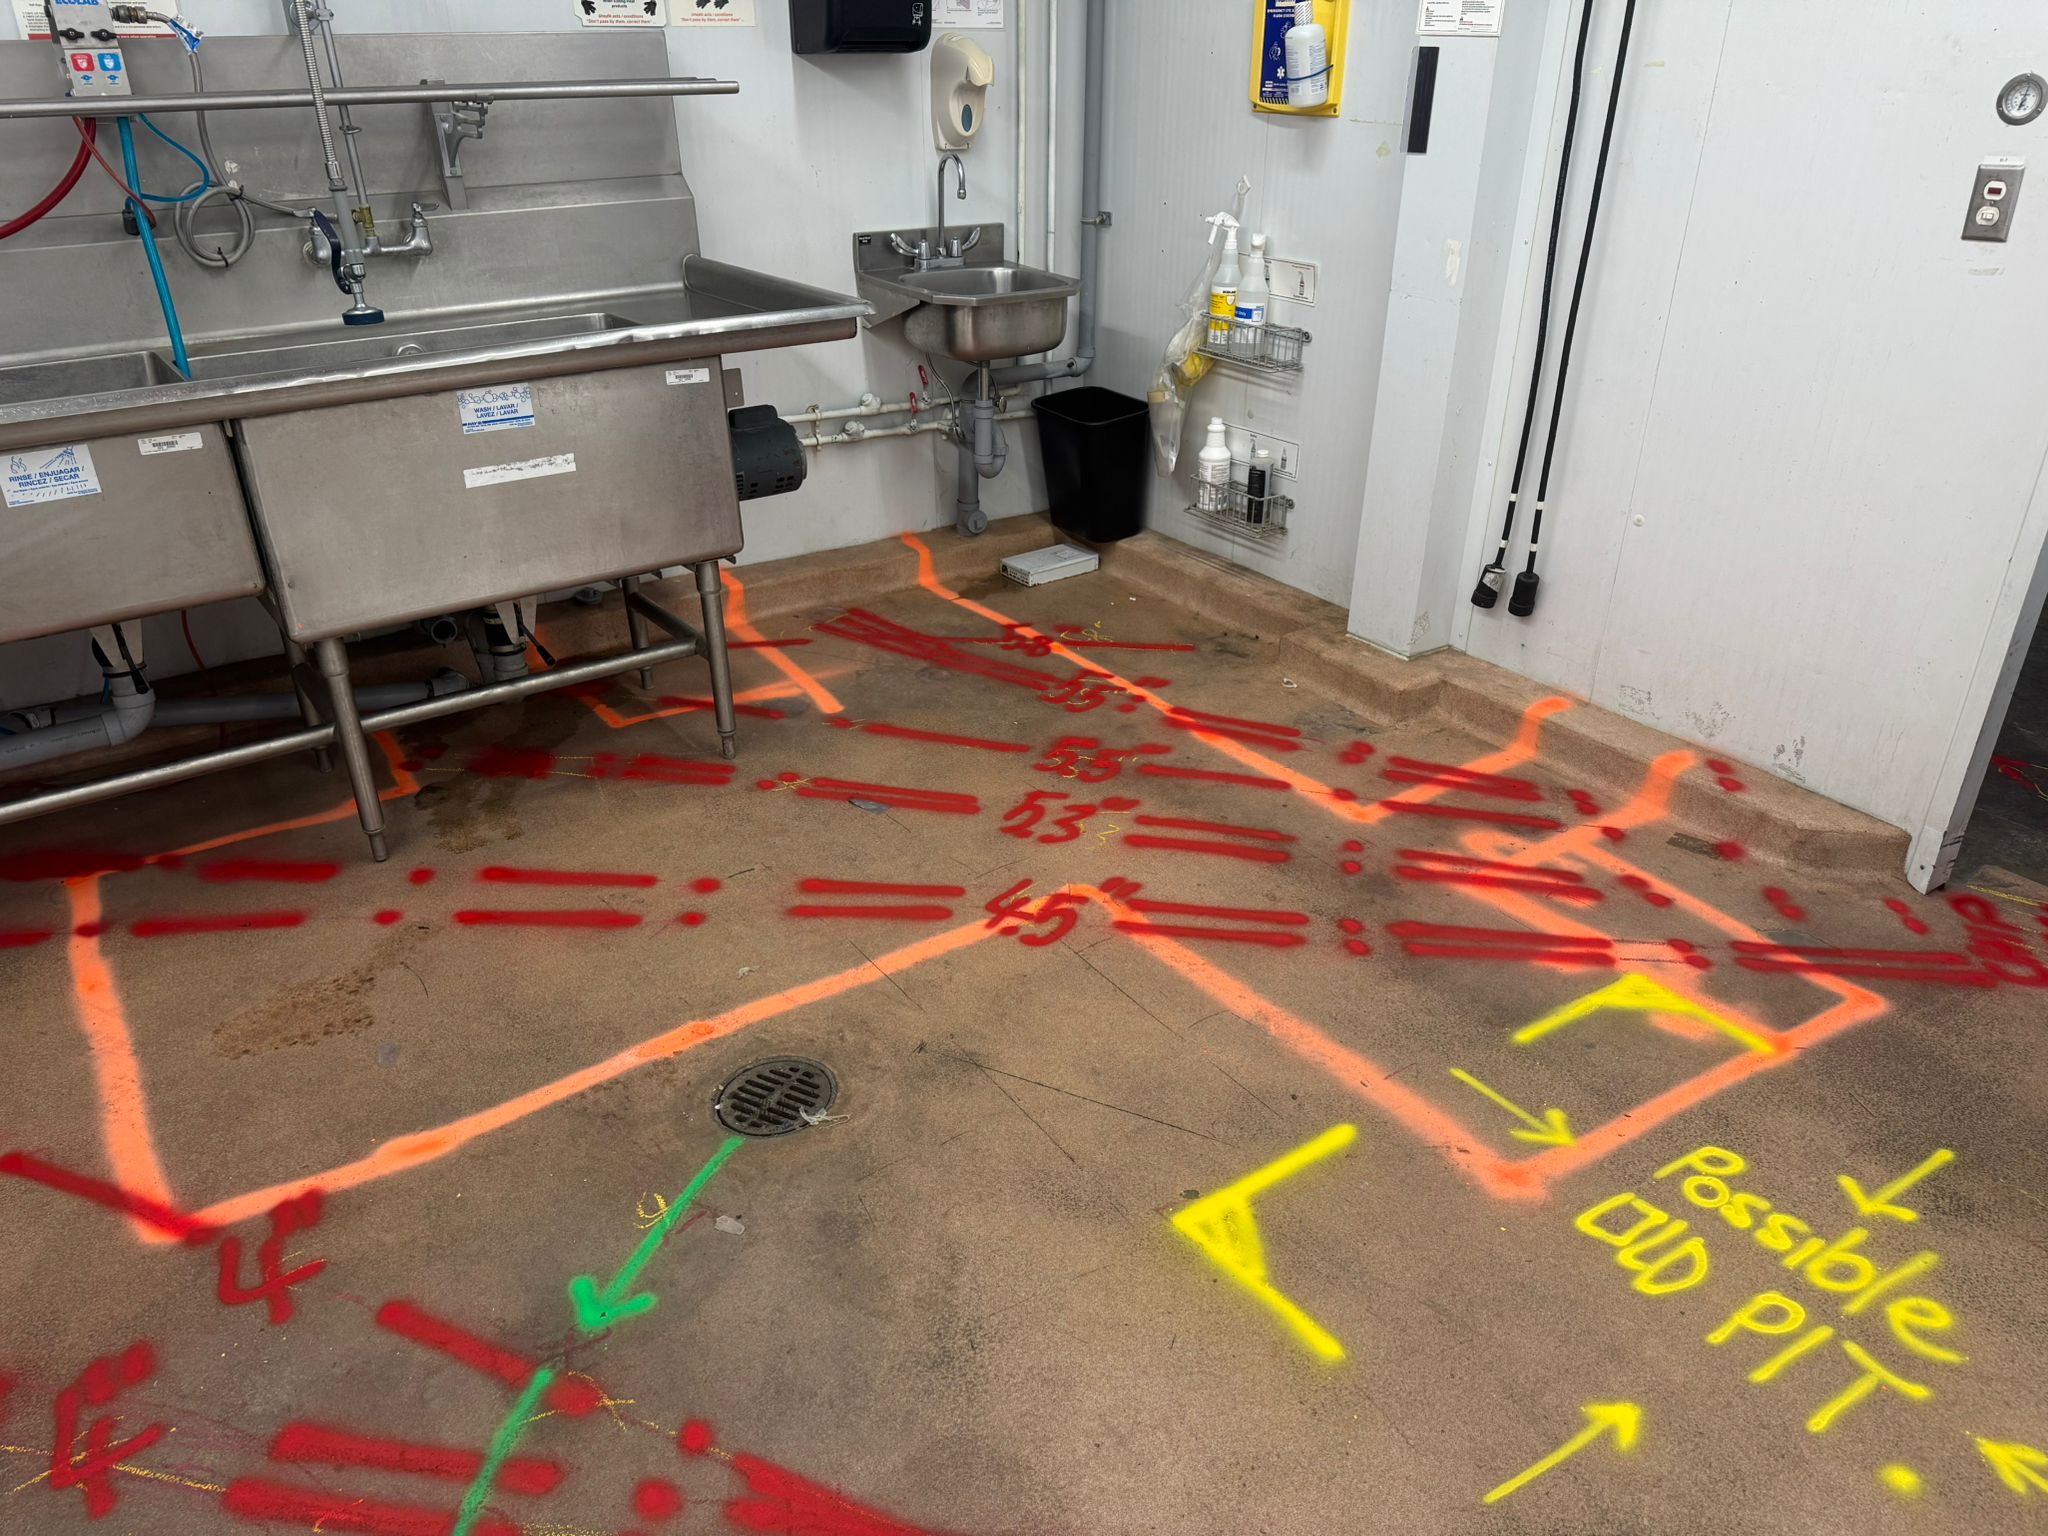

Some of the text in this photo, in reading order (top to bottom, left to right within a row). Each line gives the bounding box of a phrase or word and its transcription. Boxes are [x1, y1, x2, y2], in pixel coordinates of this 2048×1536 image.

[476, 411, 496, 419] LAVEZ
[496, 403, 516, 411] LAVAR
[9, 473, 33, 483] RINSE
[38, 466, 80, 479] ENJUAGAR
[18, 478, 48, 488] RINCEZ
[53, 473, 80, 483] SECAR
[1574, 1191, 1710, 1296] OLD
[1705, 1290, 1935, 1434] PIT
